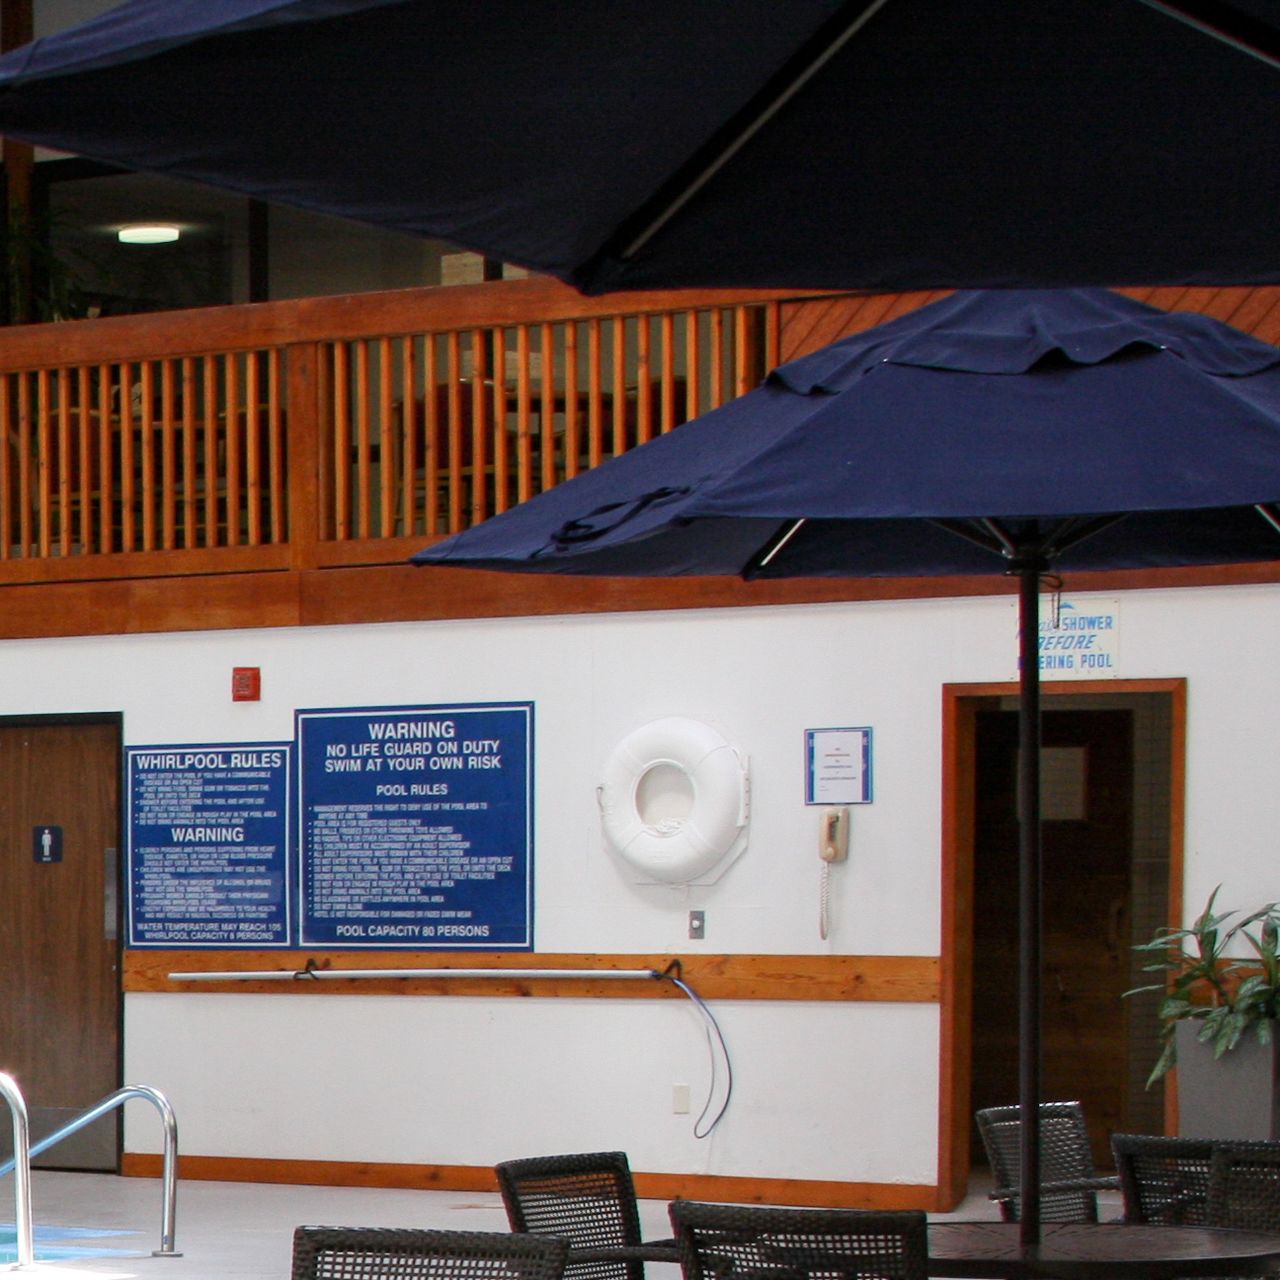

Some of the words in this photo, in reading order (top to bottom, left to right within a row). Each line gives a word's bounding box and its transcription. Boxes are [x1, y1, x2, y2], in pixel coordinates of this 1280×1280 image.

[1062, 616, 1112, 631] SHOWER
[1081, 654, 1113, 668] POOL
[368, 721, 455, 740] WARNING
[326, 744, 346, 757] NO
[351, 743, 379, 757] LIFE
[384, 742, 432, 756] GUARD
[437, 742, 458, 755] ON
[463, 740, 500, 754] DUTY
[137, 754, 227, 769] WHIRLPOOL
[231, 753, 281, 768] RULES
[325, 759, 361, 772] SWIM
[366, 758, 382, 772] AT
[387, 757, 425, 771] YOUR
[429, 757, 463, 770] OWN
[468, 755, 501, 769] RISK
[376, 784, 408, 796] POOL
[411, 784, 448, 795] RULES
[171, 827, 244, 842] WARNING
[137, 923, 162, 931] WATER
[164, 923, 220, 931] TEMPERATURE
[221, 923, 237, 931] MAY
[240, 923, 266, 931] REACH
[336, 925, 366, 936] POOL
[368, 925, 420, 936] CAPACITY
[422, 926, 434, 936] 80
[437, 925, 490, 936] PERSONS
[144, 932, 189, 940] WHIRLPOOL
[237, 932, 273, 940] PERSONS
